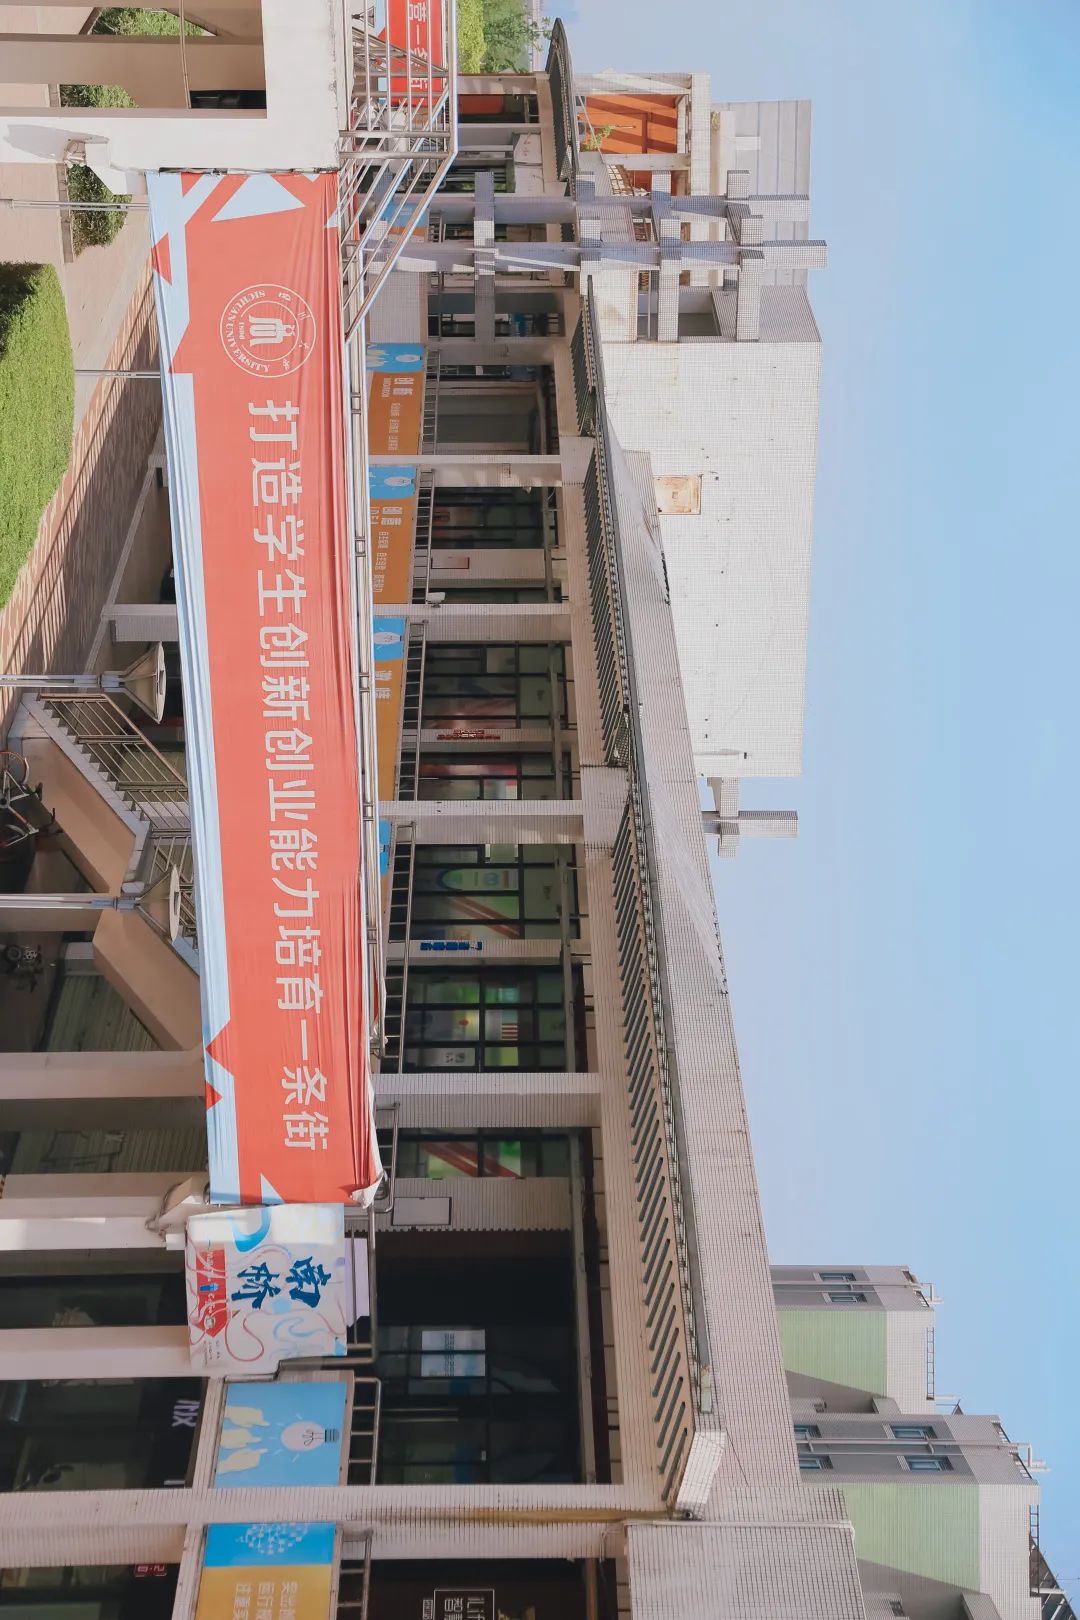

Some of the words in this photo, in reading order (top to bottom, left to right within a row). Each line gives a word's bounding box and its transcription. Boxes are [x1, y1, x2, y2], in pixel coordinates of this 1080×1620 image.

[248, 399, 329, 1150] 打造学生创新创业能力培育一条街
[231, 1256, 332, 1310] 南桥
